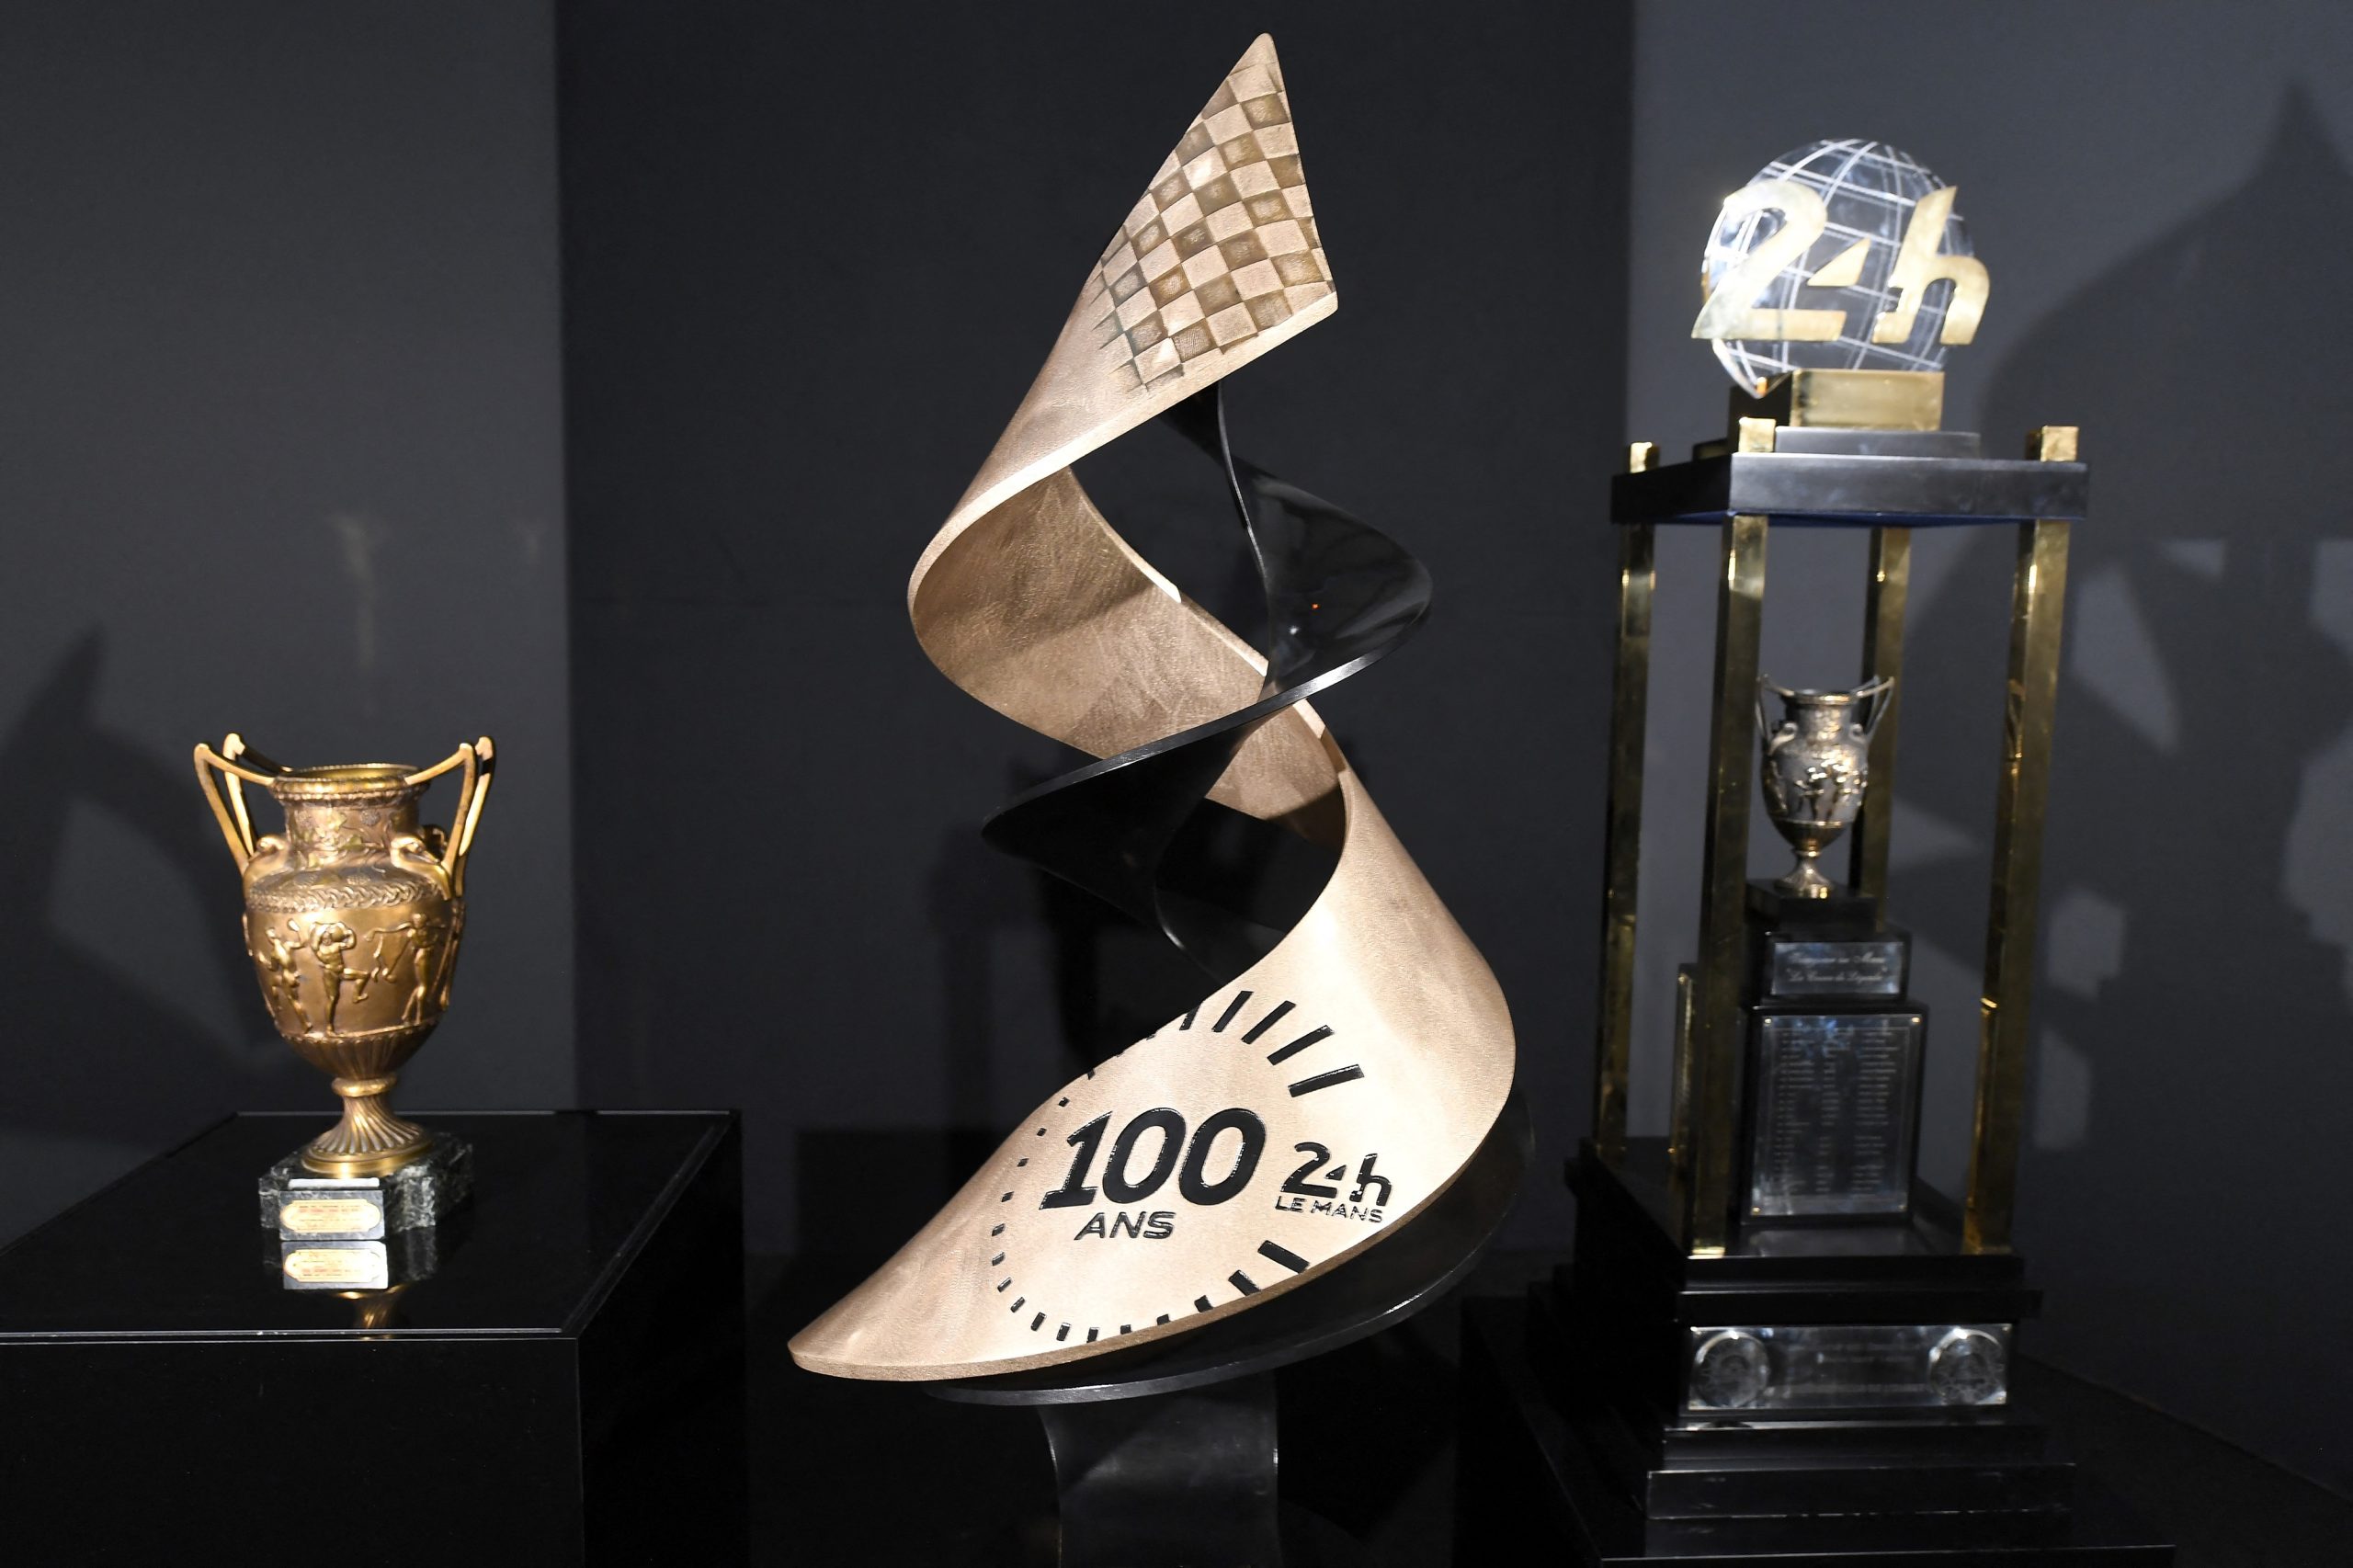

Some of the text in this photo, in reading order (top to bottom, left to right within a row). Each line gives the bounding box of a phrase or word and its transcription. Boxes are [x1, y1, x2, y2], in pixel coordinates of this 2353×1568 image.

[1691, 180, 1991, 346] 24h
[1039, 1107, 1267, 1210] 100
[1280, 1142, 1392, 1207] 24h
[1074, 1210, 1176, 1241] ANS
[1275, 1196, 1383, 1223] LE MANS
